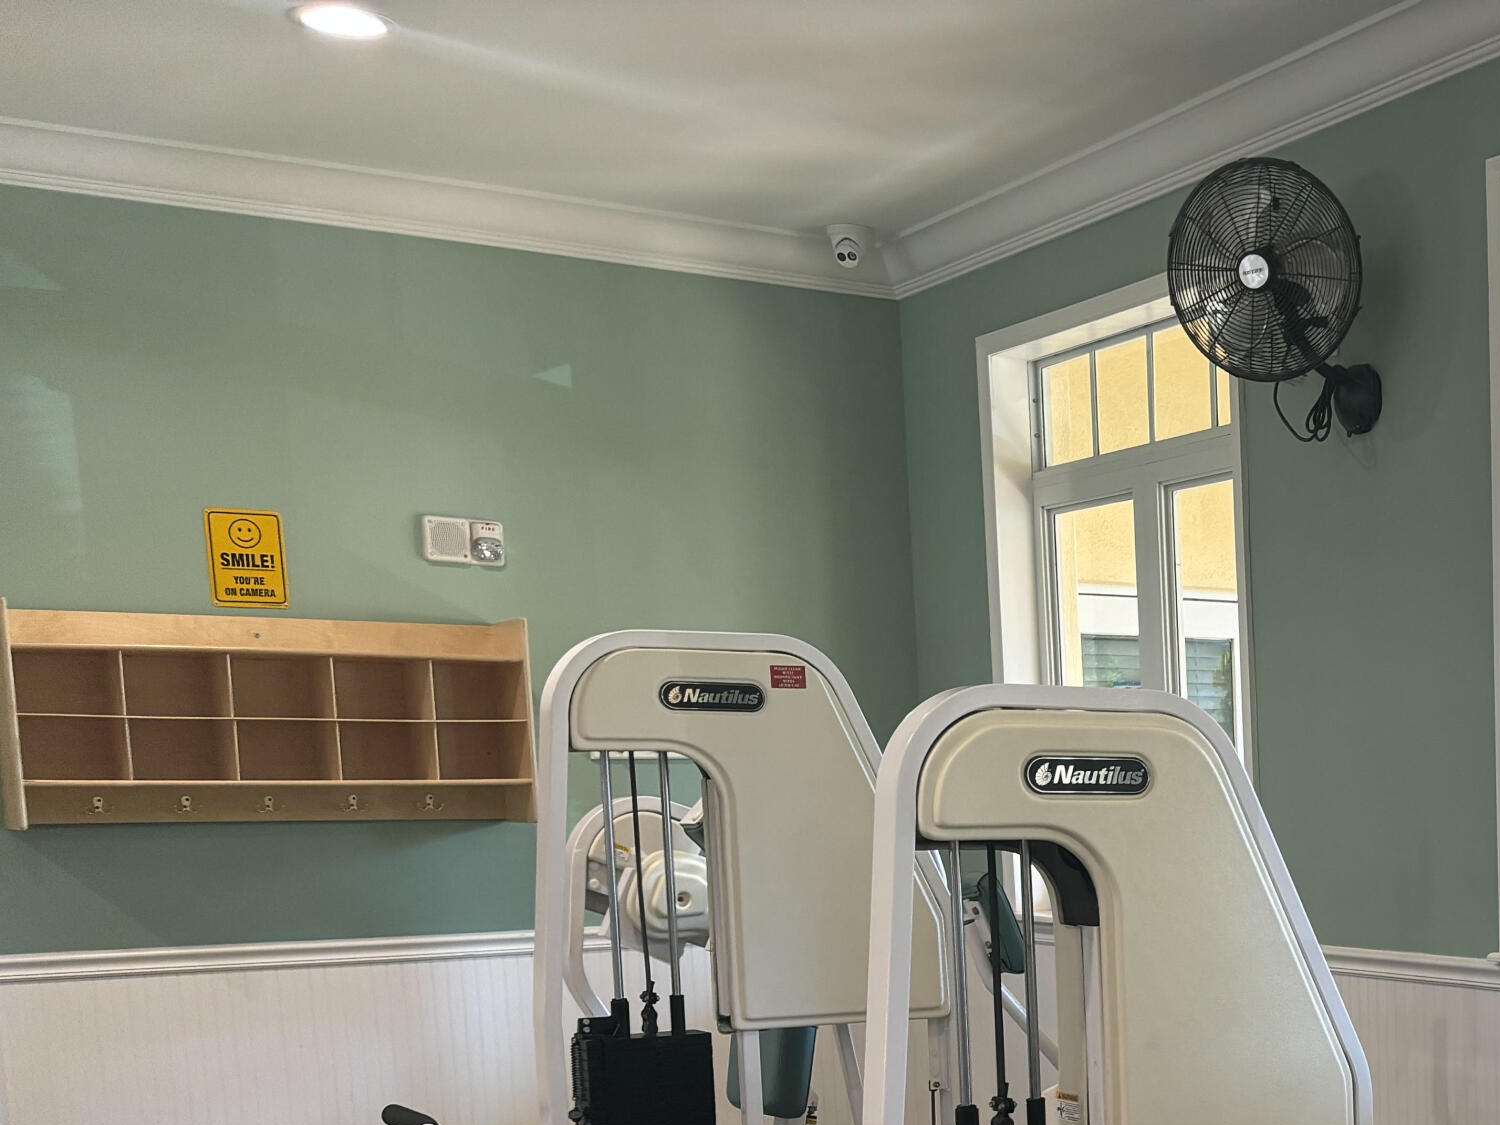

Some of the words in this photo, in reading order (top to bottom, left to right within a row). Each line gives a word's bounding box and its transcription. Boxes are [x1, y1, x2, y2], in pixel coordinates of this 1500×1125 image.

[220, 552, 276, 569] SMILE!
[233, 575, 265, 586] YOU'RE
[225, 587, 237, 596] ON
[239, 588, 276, 598] CAMERA
[683, 688, 758, 705] Nautilus
[1053, 764, 1143, 785] Nautilus
